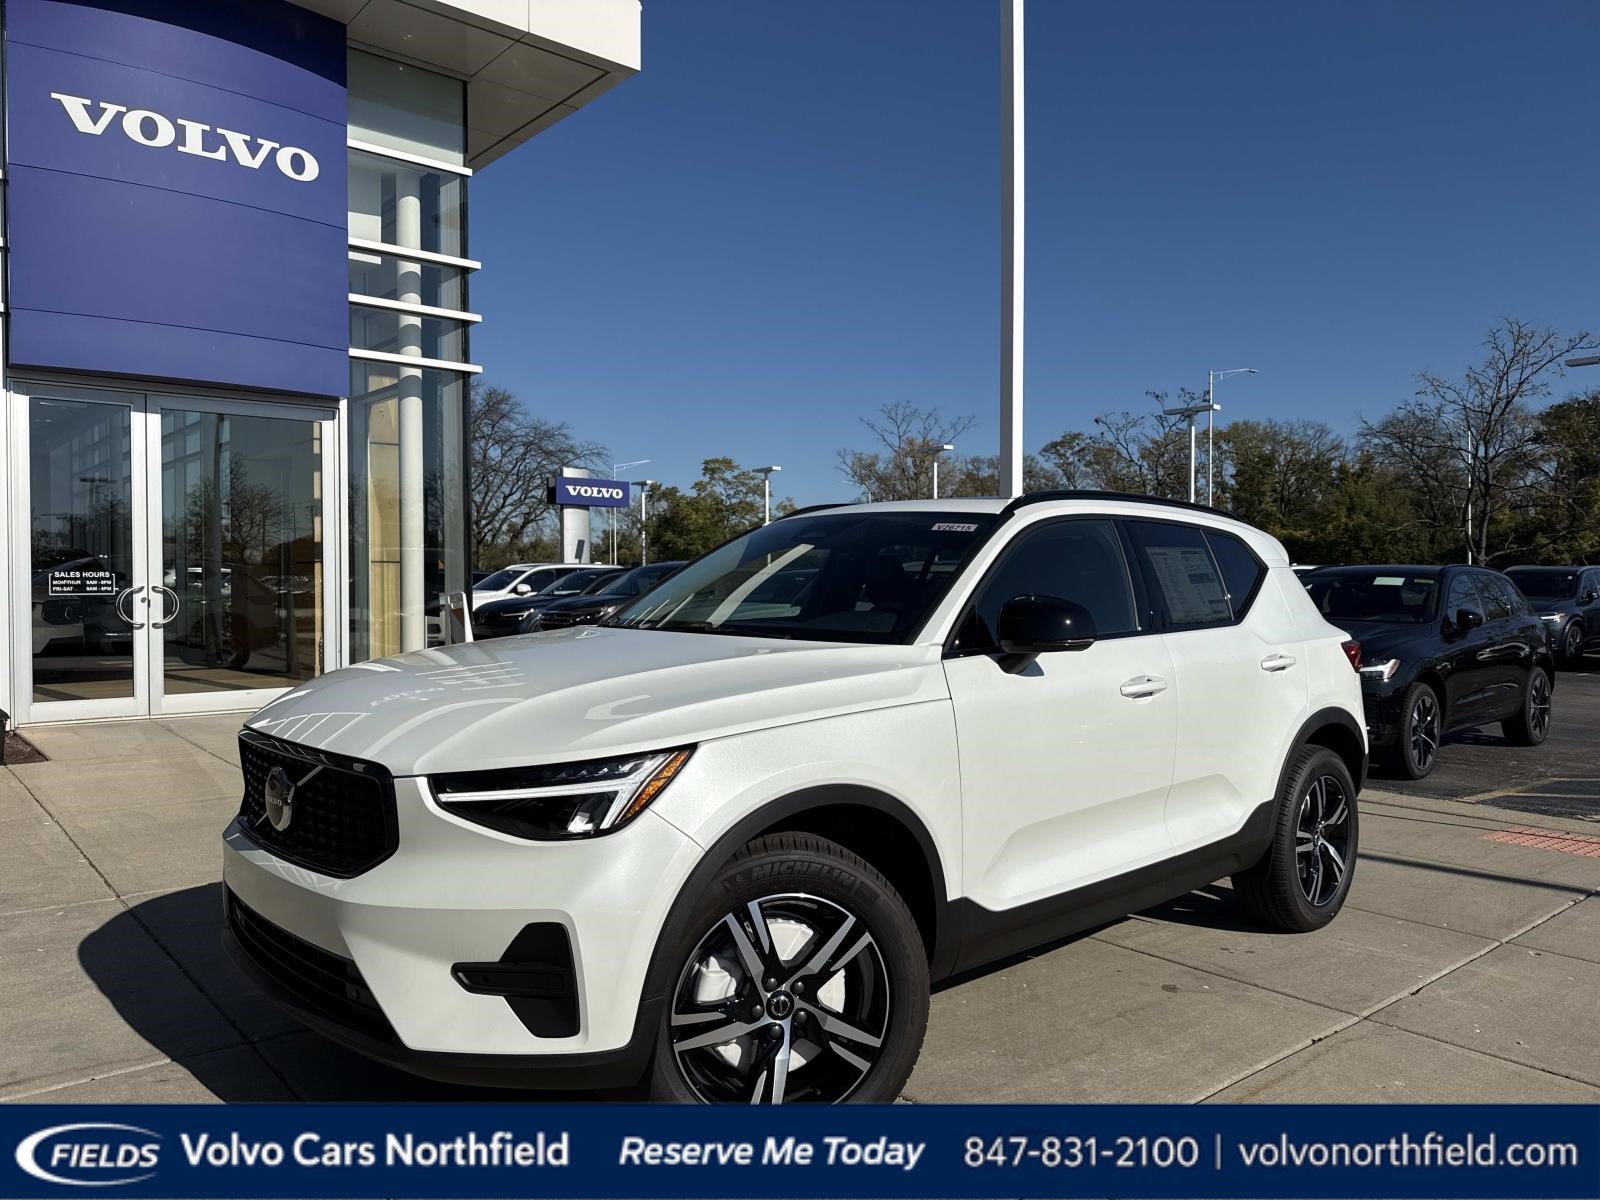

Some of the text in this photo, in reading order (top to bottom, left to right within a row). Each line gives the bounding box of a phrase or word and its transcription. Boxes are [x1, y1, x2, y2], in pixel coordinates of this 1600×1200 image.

[51, 92, 320, 183] VOLVO
[565, 485, 624, 499] VOLVO
[751, 861, 857, 887] MICHELIN
